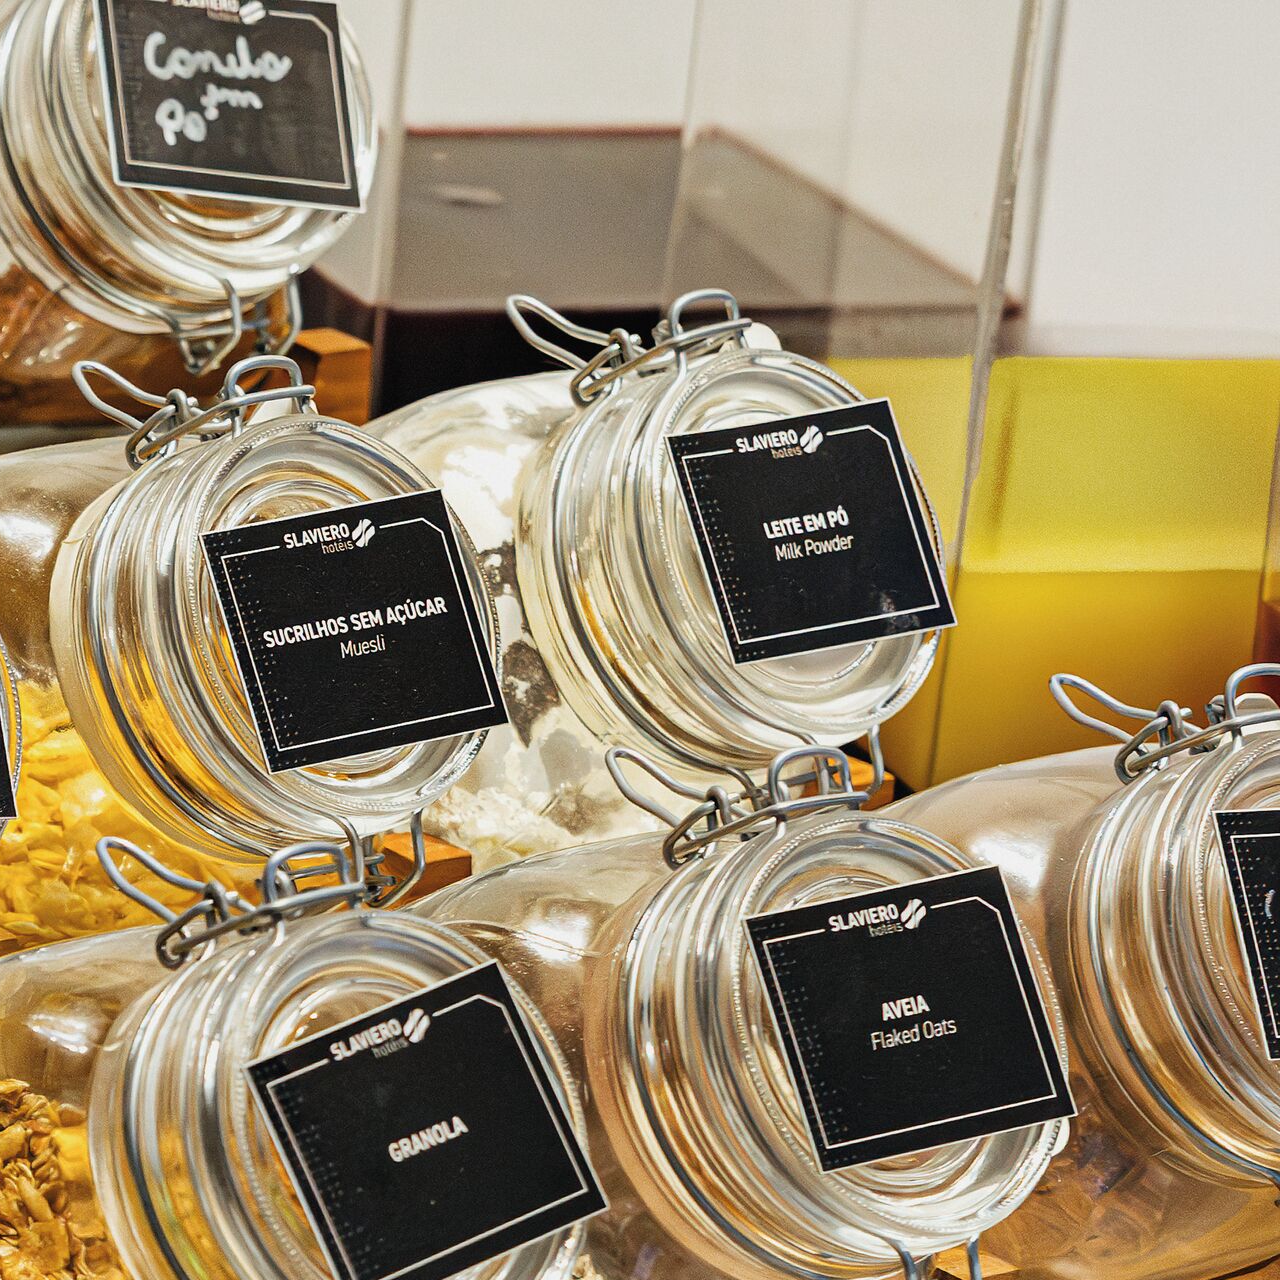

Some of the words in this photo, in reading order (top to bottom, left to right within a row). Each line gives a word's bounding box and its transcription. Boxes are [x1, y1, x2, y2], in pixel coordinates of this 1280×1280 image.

[735, 429, 799, 453] SLAVIERO
[283, 522, 351, 549] SLAVIERO
[762, 517, 803, 539] LEITE
[803, 512, 827, 533] EM
[827, 505, 850, 528] PÓ
[321, 540, 355, 555] hotéis
[774, 542, 803, 562] Milk
[805, 534, 855, 557] Powder
[263, 616, 349, 648] SUCRILHOS
[351, 609, 384, 632] SEM
[386, 596, 448, 626] AÇÚCAR
[340, 633, 387, 659] Muesli
[827, 903, 900, 932] SLAVIERO
[882, 995, 930, 1021] AVEIA
[329, 1018, 402, 1061] SLAVIERO
[870, 1025, 920, 1051] Flaked
[922, 1017, 957, 1039] Oats
[387, 1115, 469, 1163] GRANOLA
